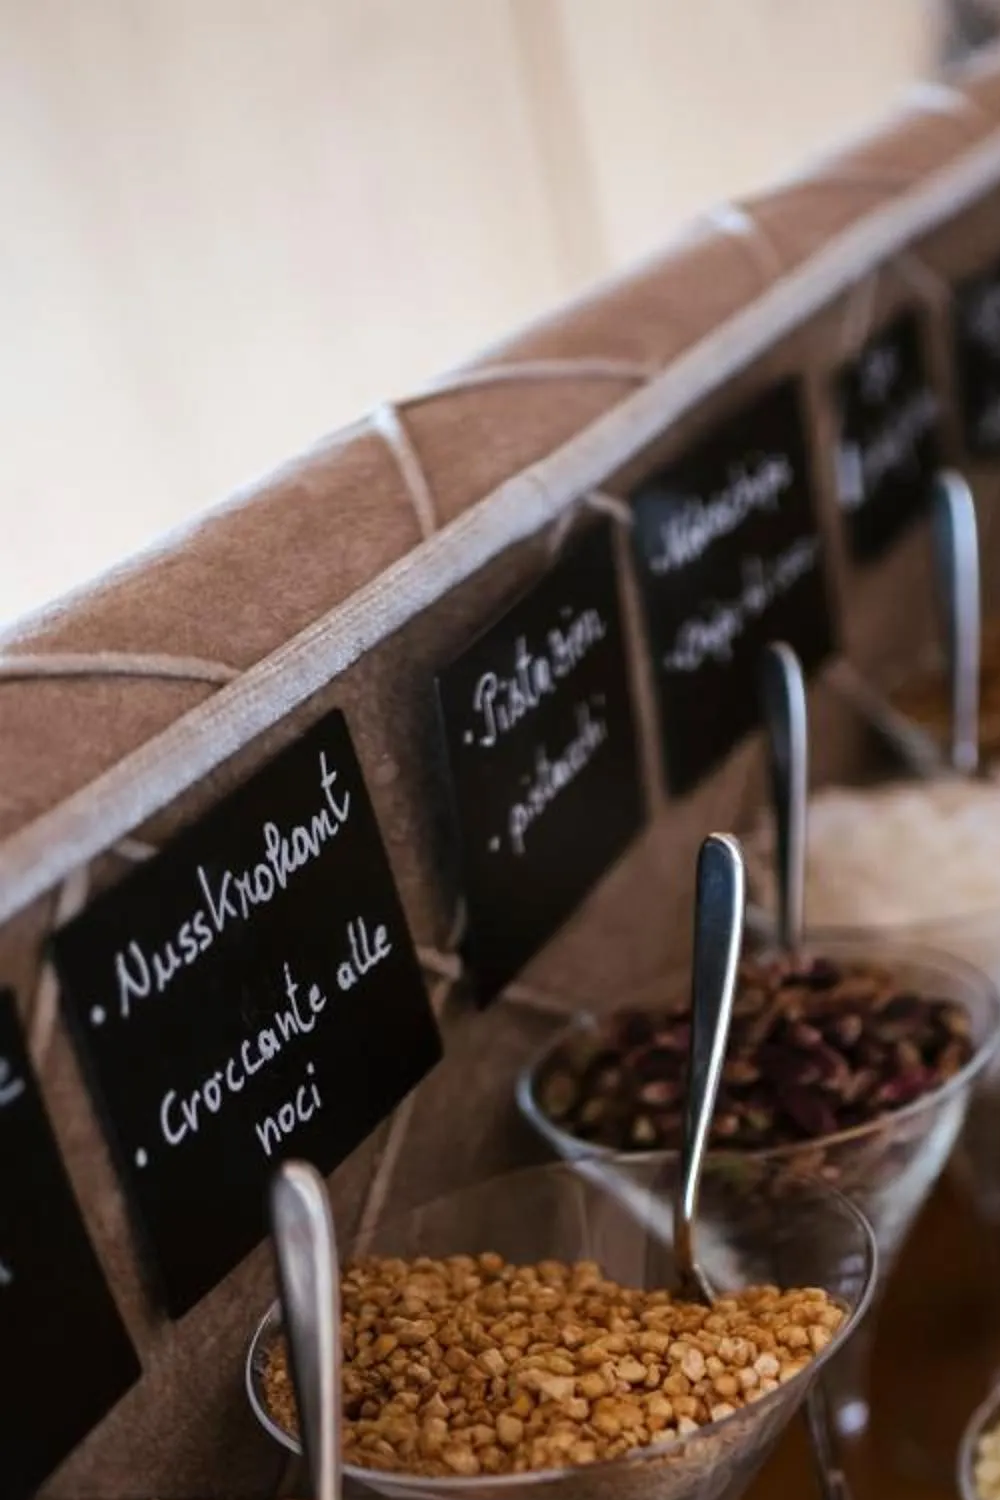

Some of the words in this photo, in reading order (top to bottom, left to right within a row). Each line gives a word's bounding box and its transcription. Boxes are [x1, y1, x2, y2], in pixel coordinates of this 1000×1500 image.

[160, 962, 327, 1146] Croccante
[337, 915, 393, 991] alle
[255, 1062, 322, 1156] noci
